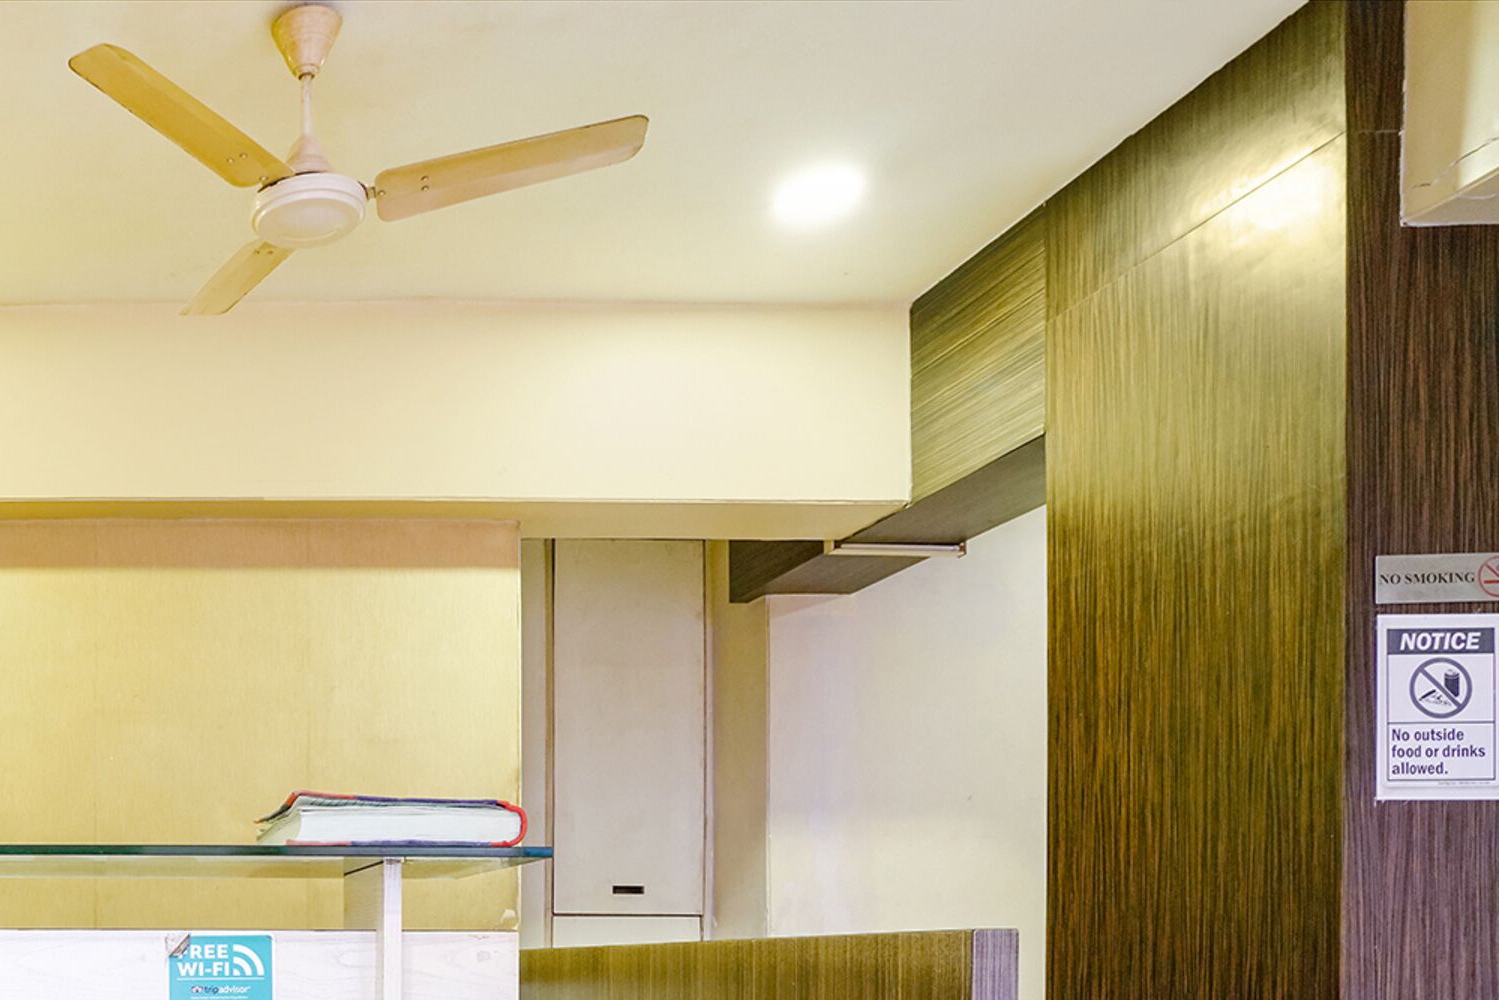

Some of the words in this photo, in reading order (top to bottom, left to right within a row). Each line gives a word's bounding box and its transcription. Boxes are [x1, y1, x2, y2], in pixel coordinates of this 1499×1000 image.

[1379, 573, 1401, 585] NO
[1404, 572, 1476, 584] SMOKING
[1400, 632, 1481, 651] NOTICE
[1392, 729, 1410, 741] No
[1414, 728, 1464, 741] outside
[1392, 745, 1422, 758] food
[1425, 748, 1439, 758] or
[1442, 745, 1486, 757] drinks
[1392, 762, 1448, 775] allowed.
[179, 944, 228, 959] REE
[177, 961, 230, 976] WI-FI
